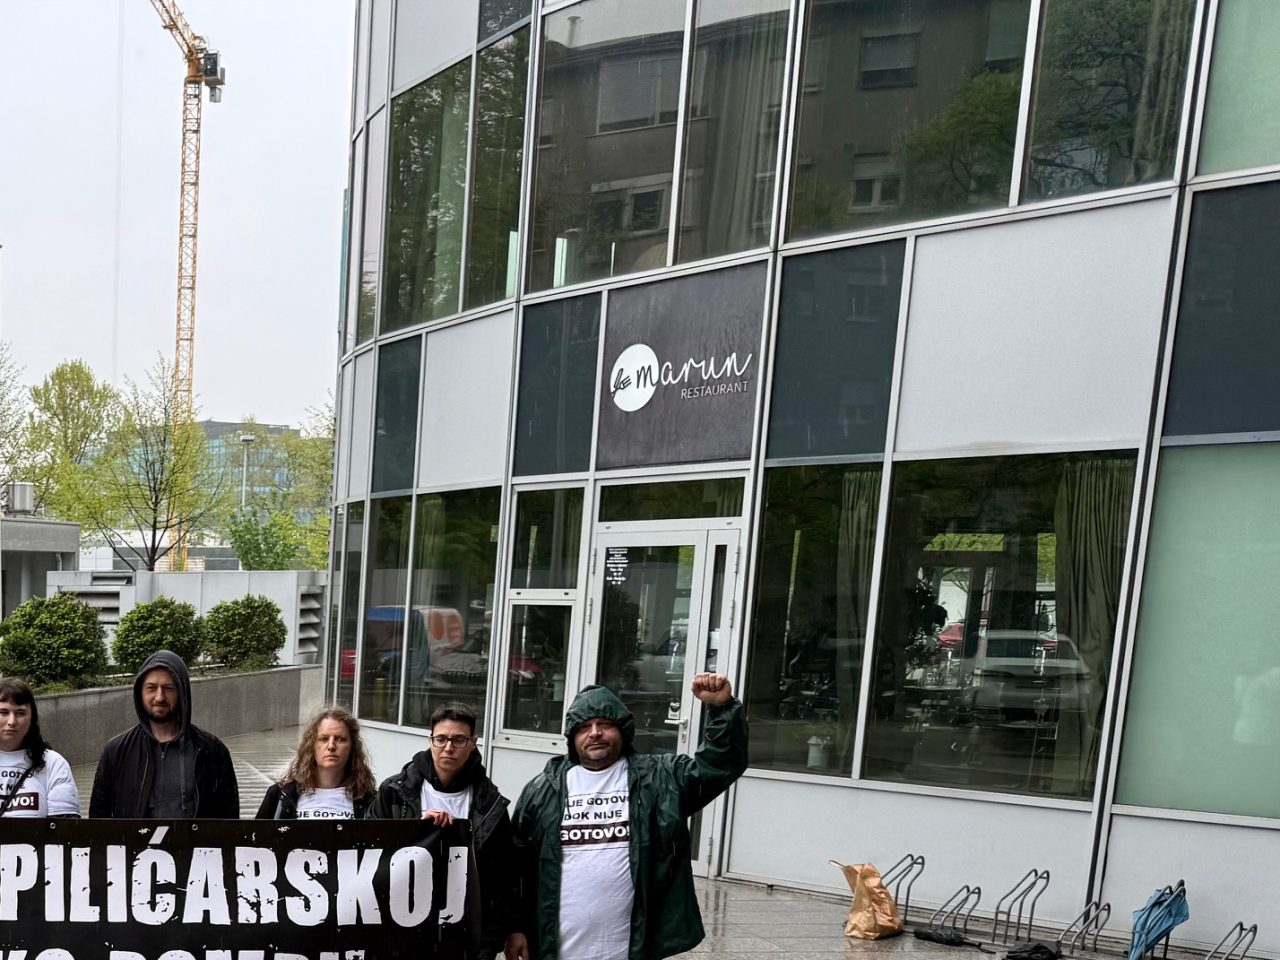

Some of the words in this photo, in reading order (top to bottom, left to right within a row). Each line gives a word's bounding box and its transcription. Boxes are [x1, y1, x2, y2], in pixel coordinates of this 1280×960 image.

[681, 380, 749, 400] RESTAURANT
[593, 809, 623, 820] NIJE
[560, 825, 630, 841] GOTOVO!
